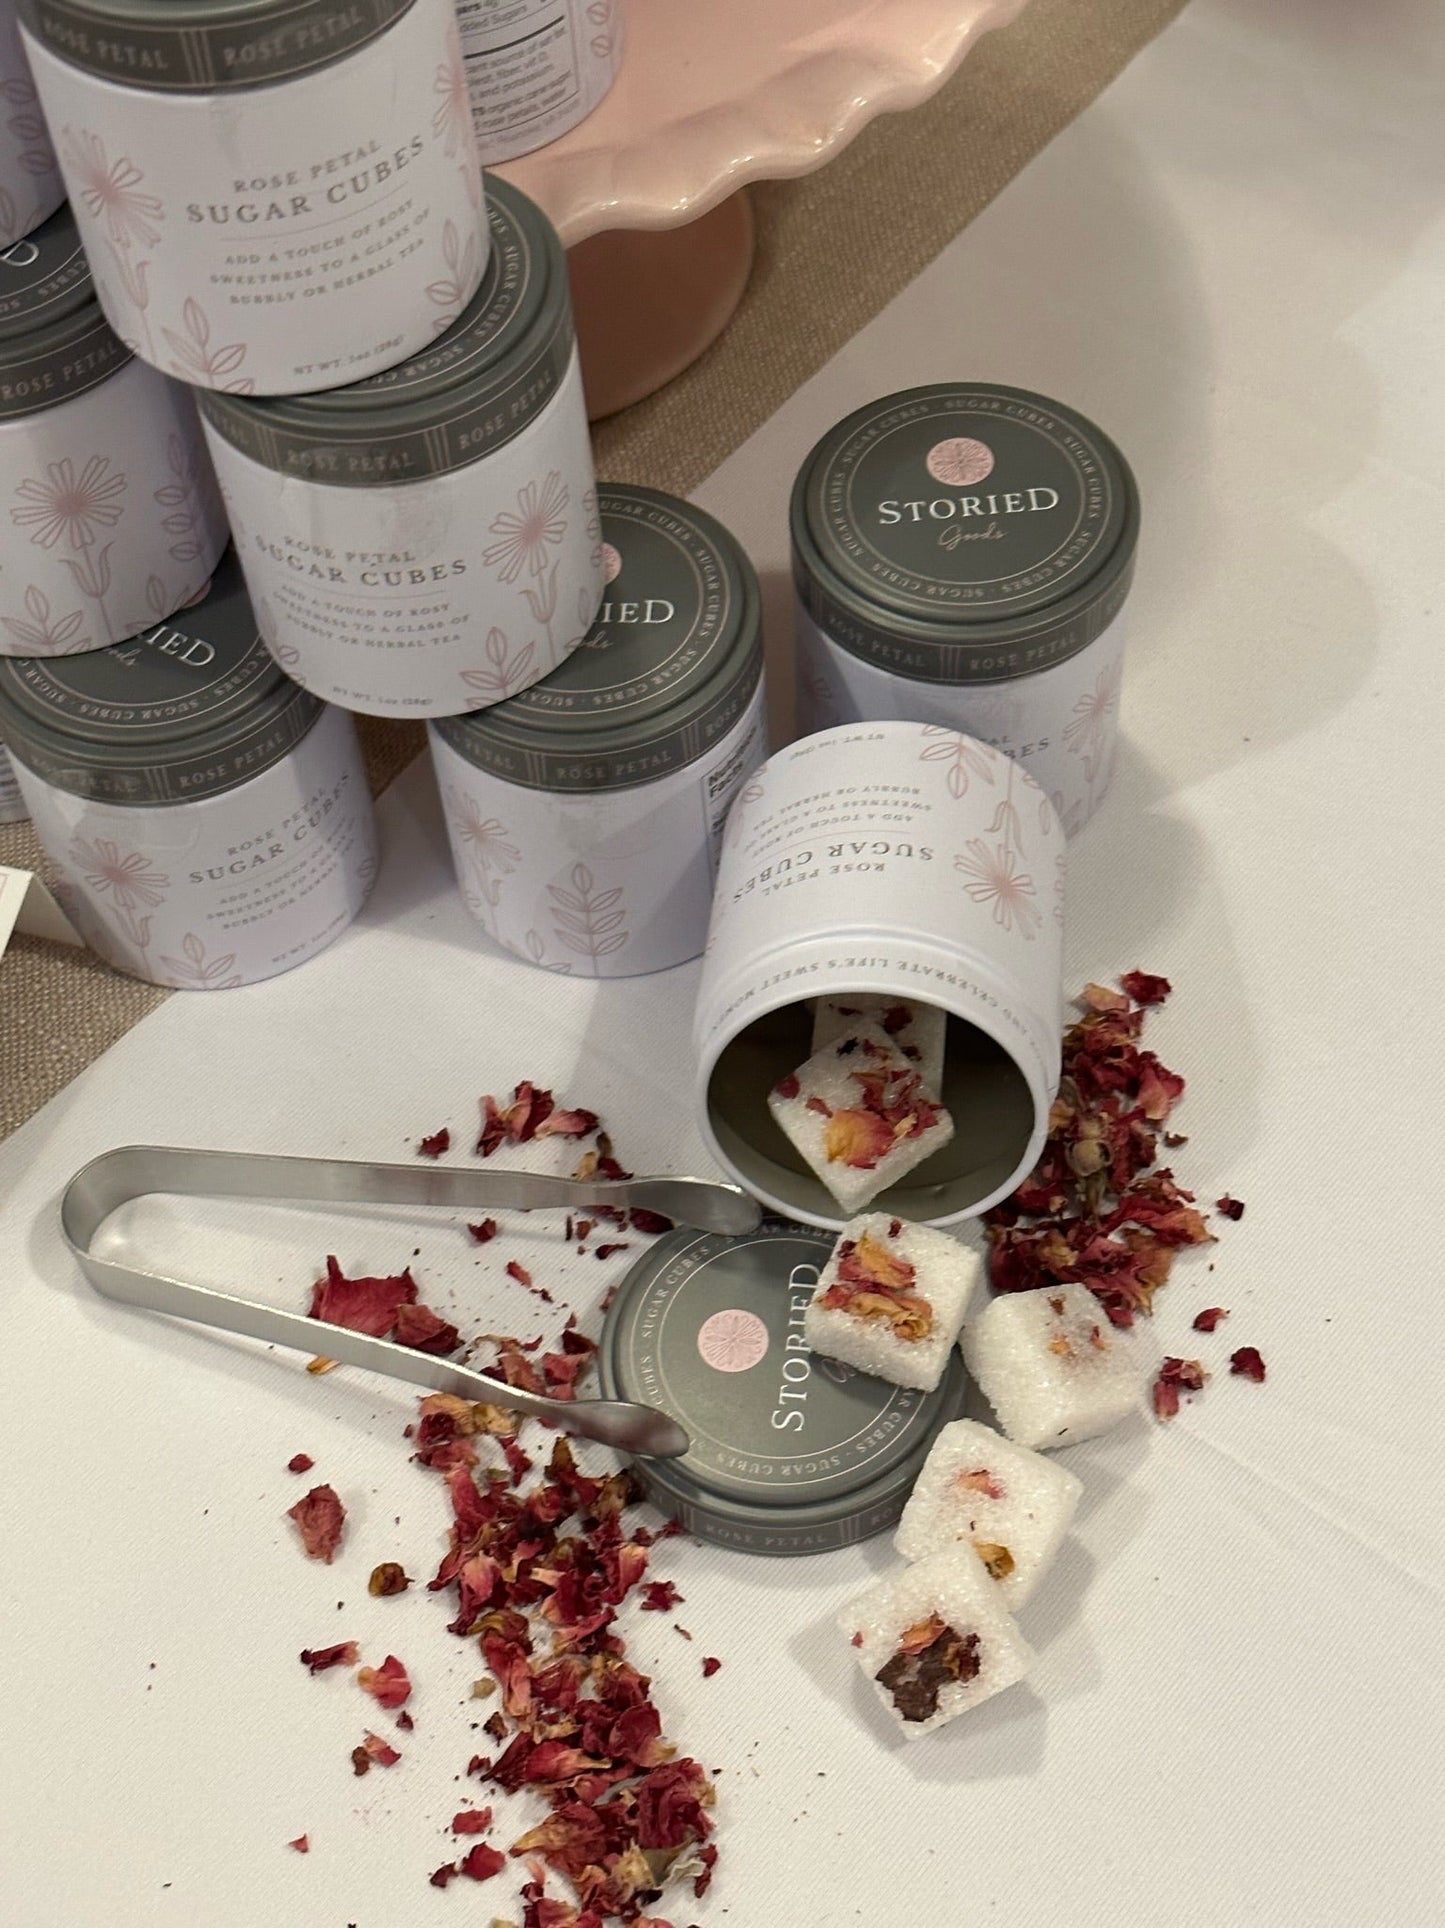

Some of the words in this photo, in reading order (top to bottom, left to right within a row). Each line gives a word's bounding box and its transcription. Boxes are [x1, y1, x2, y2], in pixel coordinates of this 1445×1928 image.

[186, 196, 312, 225] SUGAR
[326, 134, 425, 205] CUBES
[233, 171, 299, 194] ROSE
[310, 139, 381, 180] PETAL
[209, 267, 314, 286] SWEETNESS
[320, 258, 344, 274] TO
[351, 253, 361, 264] A
[365, 225, 411, 257] GLASS
[414, 206, 431, 227] OF
[224, 252, 261, 266] ADD
[269, 253, 280, 263] A
[285, 236, 346, 260] TOUCH
[352, 224, 371, 240] OF
[229, 290, 297, 305] BUBBLY
[303, 284, 328, 299] OR
[333, 257, 395, 290] HERBAL
[0, 373, 54, 400] ROSE
[459, 414, 505, 449] ROSE
[511, 369, 553, 418] PETAL
[1006, 406, 1055, 430] CUBES
[349, 451, 413, 471] PETAL
[1064, 436, 1096, 475] SUGAR
[598, 500, 645, 514] UGAR
[878, 487, 1059, 525] STORIED
[284, 536, 336, 560] ROSE
[345, 551, 416, 564] PETAL
[937, 521, 1009, 550] Goods
[255, 534, 347, 583] SUGAR
[361, 559, 467, 587] CUBES
[325, 602, 377, 617] TOUCH
[383, 609, 402, 618] OF
[410, 603, 450, 616] ROSY
[354, 623, 375, 633] TO
[396, 621, 445, 633] GLASS
[451, 614, 470, 625] OF
[339, 635, 359, 645] OR
[365, 638, 426, 648] HERBAL
[431, 634, 461, 646] TEA
[970, 654, 1017, 671] ROSE
[1025, 632, 1076, 656] PETAL
[651, 649, 697, 685] SUGAR
[141, 700, 199, 719] SUGAR
[180, 763, 227, 788] ROSE
[234, 732, 285, 769] PETAL
[557, 766, 606, 780] ROSE
[616, 750, 672, 776] PETAL
[780, 790, 833, 814] HERBAL
[836, 787, 856, 796] OR
[862, 785, 921, 795] BUBBLY
[802, 809, 810, 817] A
[815, 803, 836, 815] TO
[842, 799, 932, 812] SWEETNESS
[881, 813, 914, 822] ADD
[189, 843, 285, 884] SUGAR
[293, 770, 349, 841] CUBES
[785, 826, 805, 840] OF
[809, 813, 859, 830] TOUCH
[227, 829, 276, 856] ROSE
[828, 841, 935, 862] SUGAR
[219, 892, 249, 905] ADD
[264, 860, 308, 889] TOUCH
[733, 850, 814, 904] CUBES
[762, 868, 820, 897] PETAL
[830, 862, 886, 875] ROSE
[206, 889, 286, 920] SWEETNESS
[222, 909, 274, 930] BUBBLY
[278, 897, 296, 910] OR
[760, 962, 820, 991] SWEET
[828, 957, 889, 969] LIFE'S
[897, 960, 999, 1008] CELEBRATE
[642, 1288, 669, 1339] SUGAR
[666, 1246, 711, 1285] CUBES
[771, 1263, 823, 1432] STORIED
[855, 1411, 902, 1453] CUBES
[717, 1453, 773, 1475] CUBES
[781, 1455, 841, 1476] SUGAR
